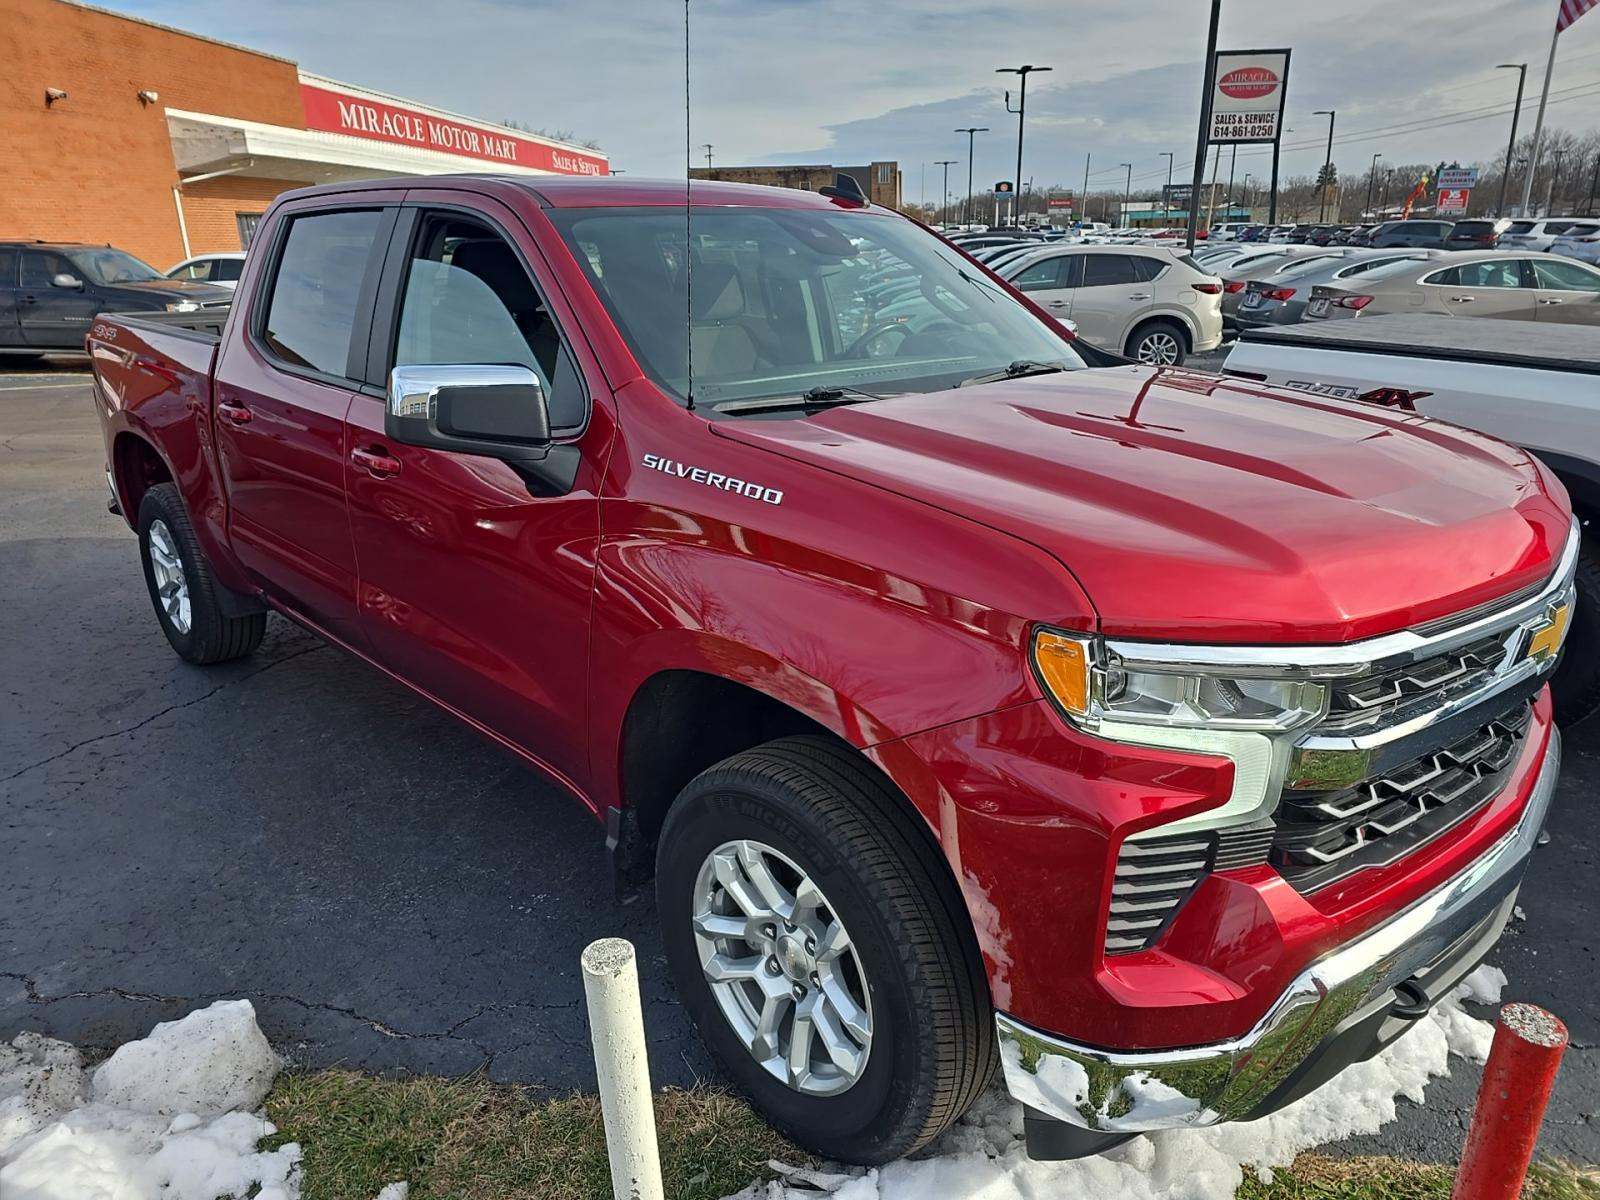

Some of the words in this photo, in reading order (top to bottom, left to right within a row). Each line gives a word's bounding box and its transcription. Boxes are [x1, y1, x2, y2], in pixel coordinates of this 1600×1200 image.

[1214, 114, 1237, 125] SALES
[1237, 115, 1243, 125] &
[1244, 113, 1275, 124] SERVICE
[338, 101, 425, 142] MIRACLE
[428, 121, 481, 153] MOTOR
[482, 135, 517, 161] MART
[1214, 125, 1273, 137] 614-861-0250
[571, 159, 578, 171] &
[641, 453, 784, 505] SILVERADO
